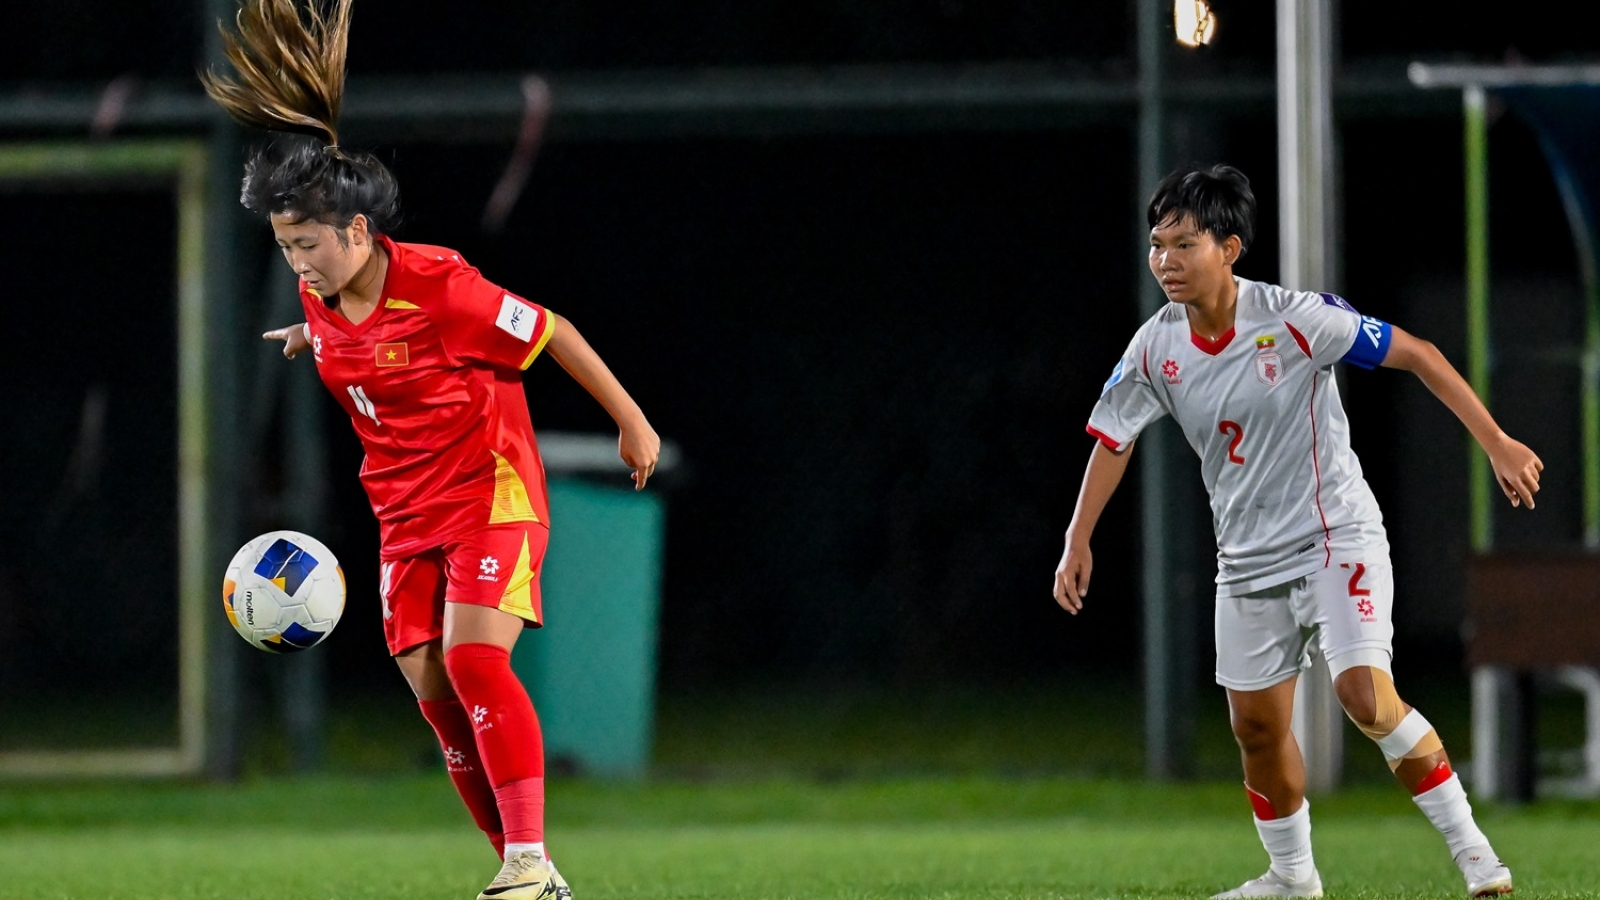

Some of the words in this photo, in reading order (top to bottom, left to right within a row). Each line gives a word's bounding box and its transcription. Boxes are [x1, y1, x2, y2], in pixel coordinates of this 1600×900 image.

[511, 306, 523, 331] AFC
[346, 385, 382, 427] 11
[1218, 420, 1246, 466] 2
[1340, 563, 1371, 597] 2
[246, 591, 254, 626] molten
